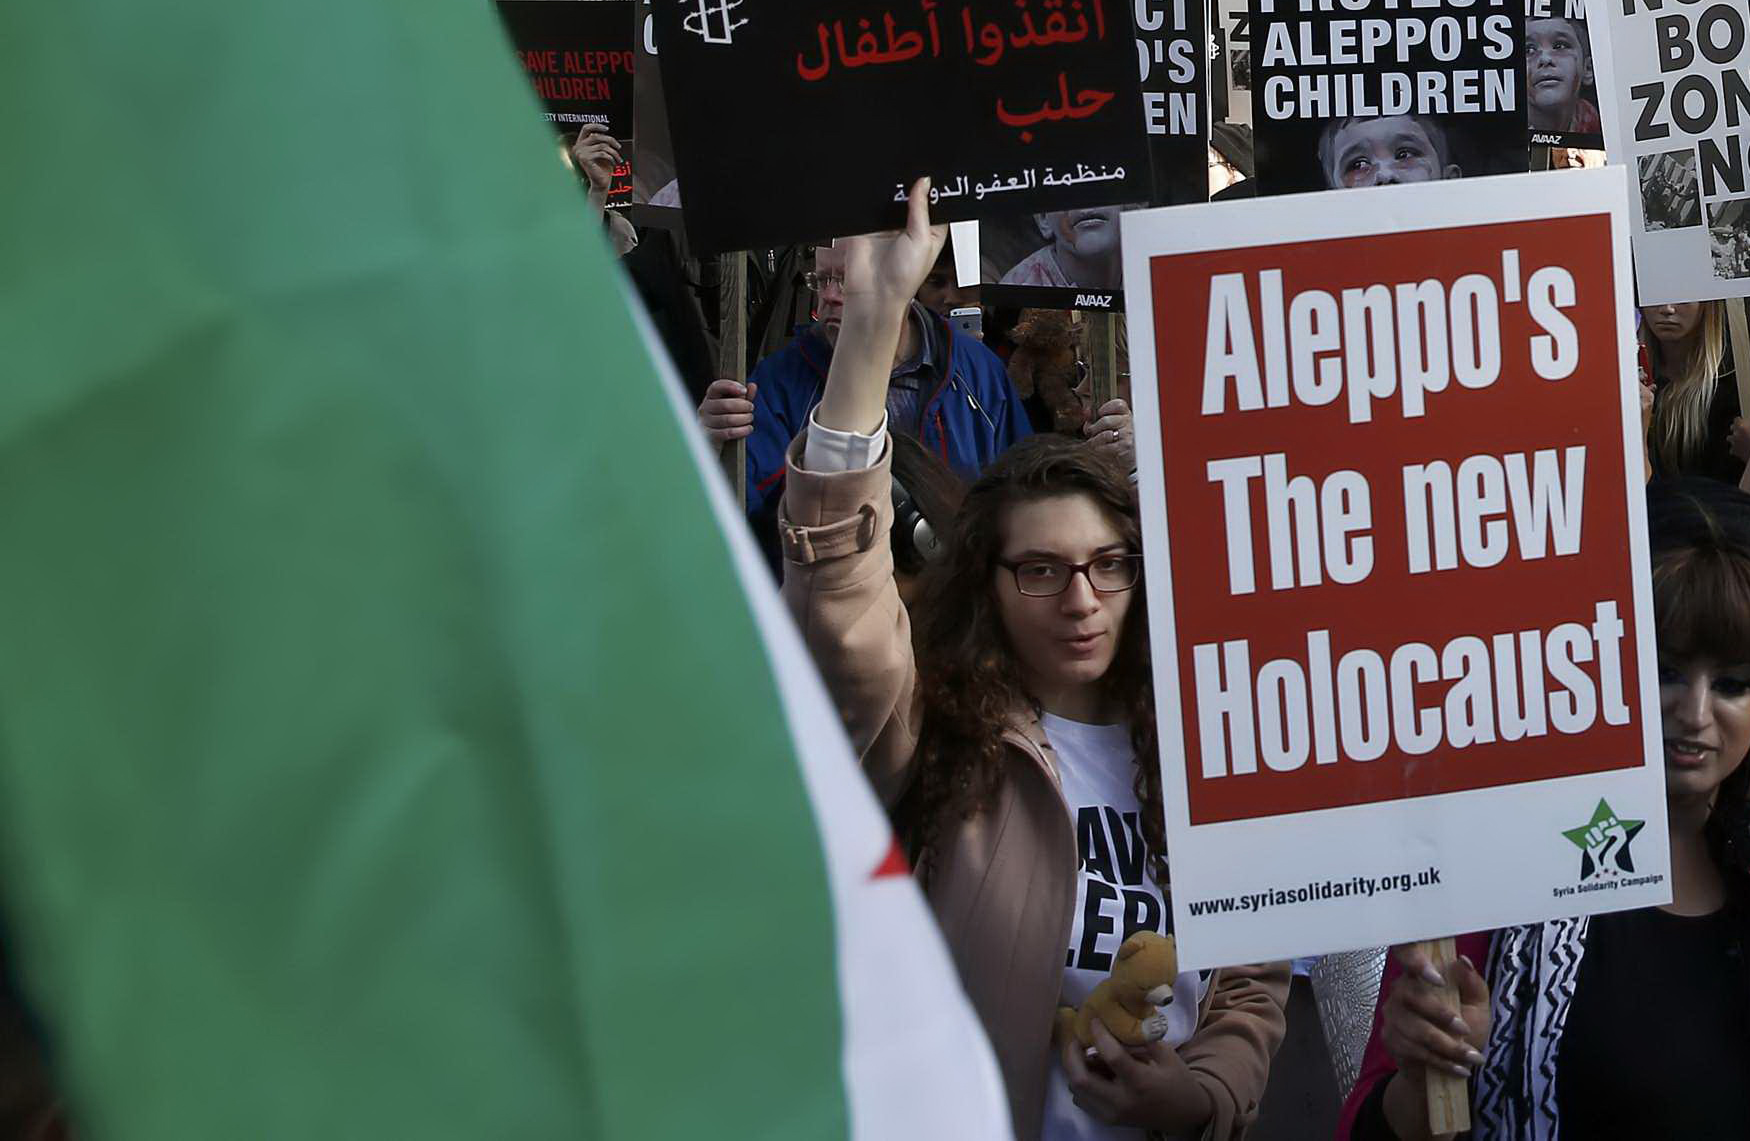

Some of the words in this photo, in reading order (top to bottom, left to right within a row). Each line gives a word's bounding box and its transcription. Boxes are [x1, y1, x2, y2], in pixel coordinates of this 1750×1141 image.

[563, 50, 637, 75] ALEPPO
[1261, 14, 1515, 67] ALEPPO'S
[533, 77, 611, 101] HILDREN
[996, 72, 1115, 144] حلب
[1263, 68, 1516, 120] CHILDREN
[974, 169, 1037, 200] العفو
[1042, 163, 1126, 186] منظمة
[1074, 294, 1113, 308] AVAAZ
[1201, 249, 1579, 424] Aleppo's
[1207, 453, 1374, 595] The
[1402, 445, 1586, 574] new
[1193, 600, 1631, 779] Holocaust
[1188, 866, 1441, 918] www.syriasolidarity.org.uk
[1553, 885, 1575, 899] Syria
[1577, 879, 1619, 895] Solidarity
[1621, 872, 1664, 889] Campaign
